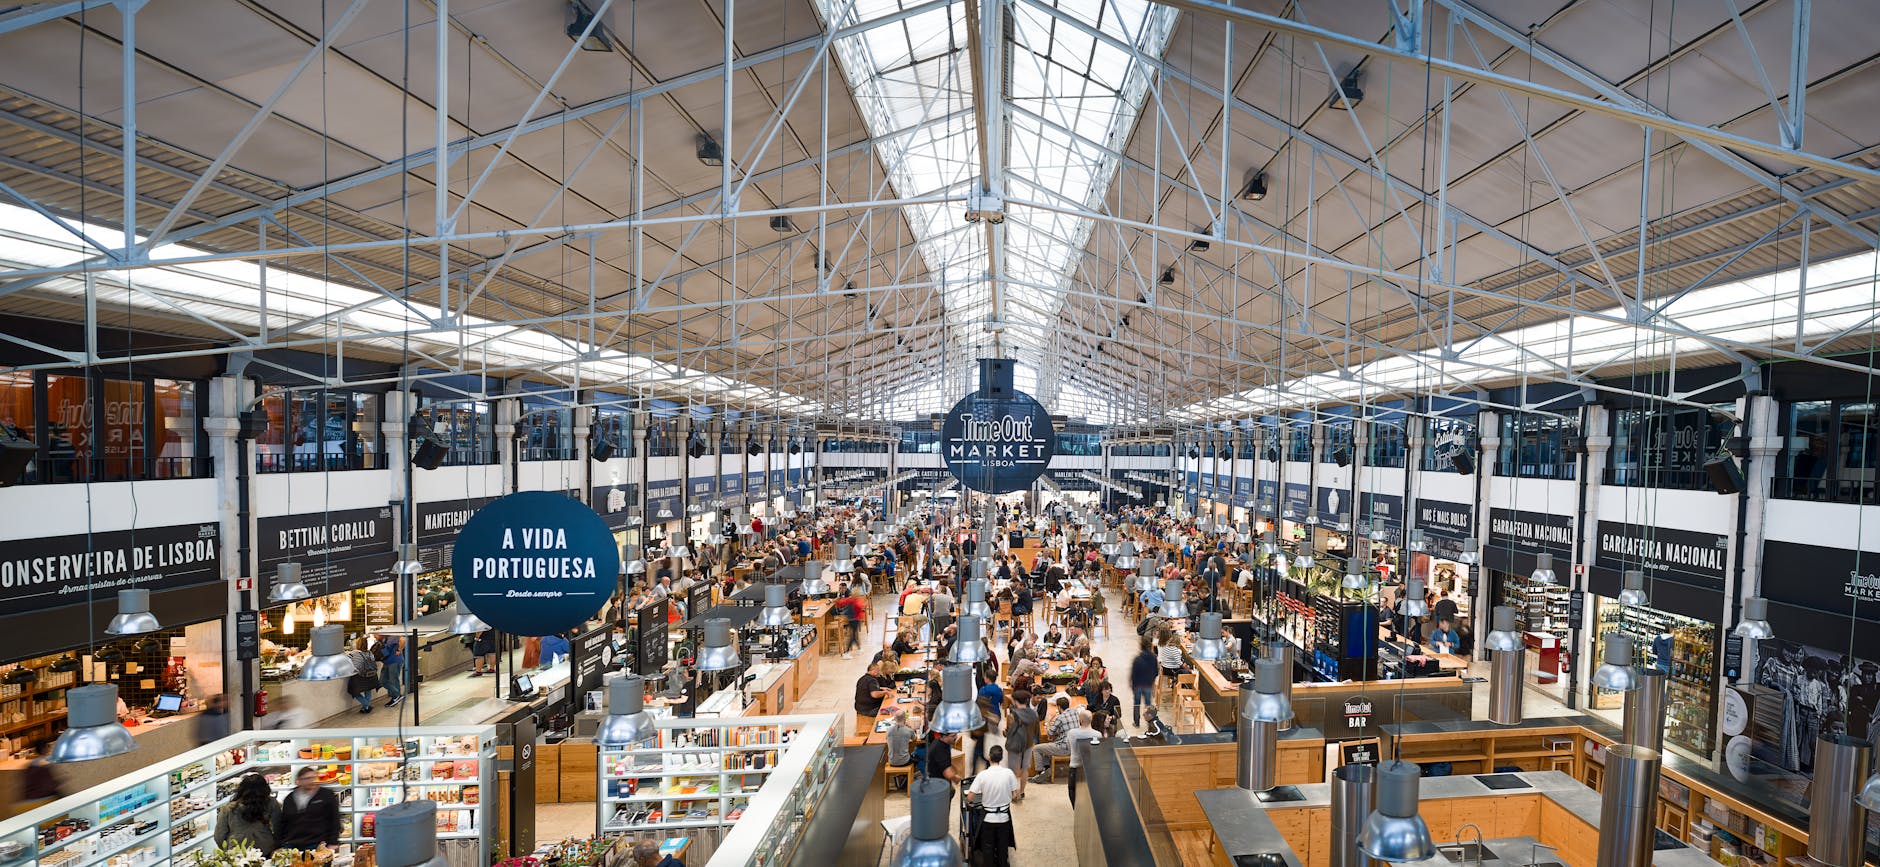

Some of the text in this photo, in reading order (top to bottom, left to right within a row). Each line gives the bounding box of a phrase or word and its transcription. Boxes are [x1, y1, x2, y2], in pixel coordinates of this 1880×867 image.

[960, 413, 1033, 442] Time Out
[950, 444, 1045, 457] MARKET
[1433, 508, 1437, 522] É
[1437, 510, 1450, 524] MAIS
[1450, 512, 1468, 527] BOLOS
[279, 519, 376, 550] BETTINA CORALLO
[502, 528, 567, 549] A VIDA
[1493, 518, 1572, 545] GARRAFEIRA NACIONAL
[1602, 533, 1662, 560] GARRAFEIRA
[1665, 543, 1723, 570] NACIONAL
[1, 538, 216, 588] ONSERVEIRA DE LISBOA
[473, 557, 596, 579] PORTUGUESA
[116, 577, 127, 586] de
[1844, 585, 1880, 598] MARKE
[506, 589, 563, 599] Desde sempre
[1348, 716, 1366, 727] BAR
